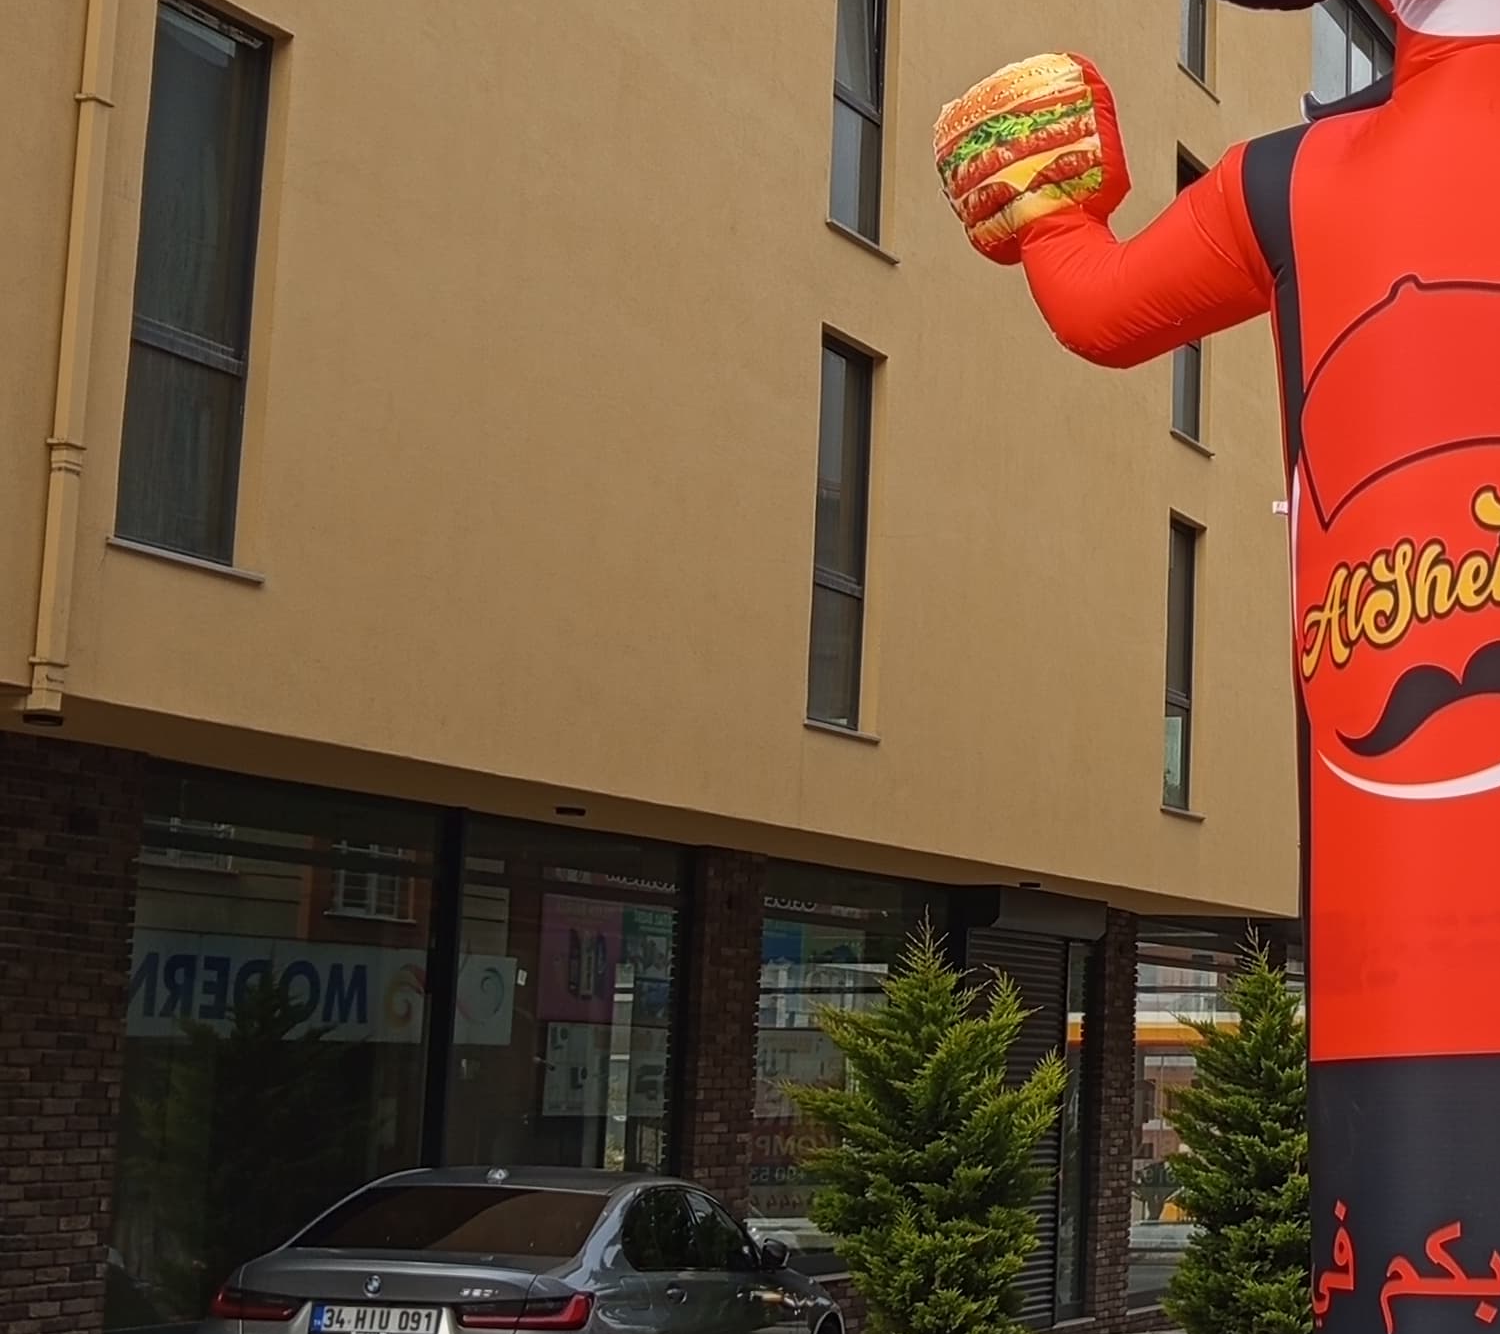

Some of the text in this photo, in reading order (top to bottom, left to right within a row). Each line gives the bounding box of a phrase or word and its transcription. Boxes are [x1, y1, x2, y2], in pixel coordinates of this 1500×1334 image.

[324, 1308, 432, 1332] 34 HIU 091
